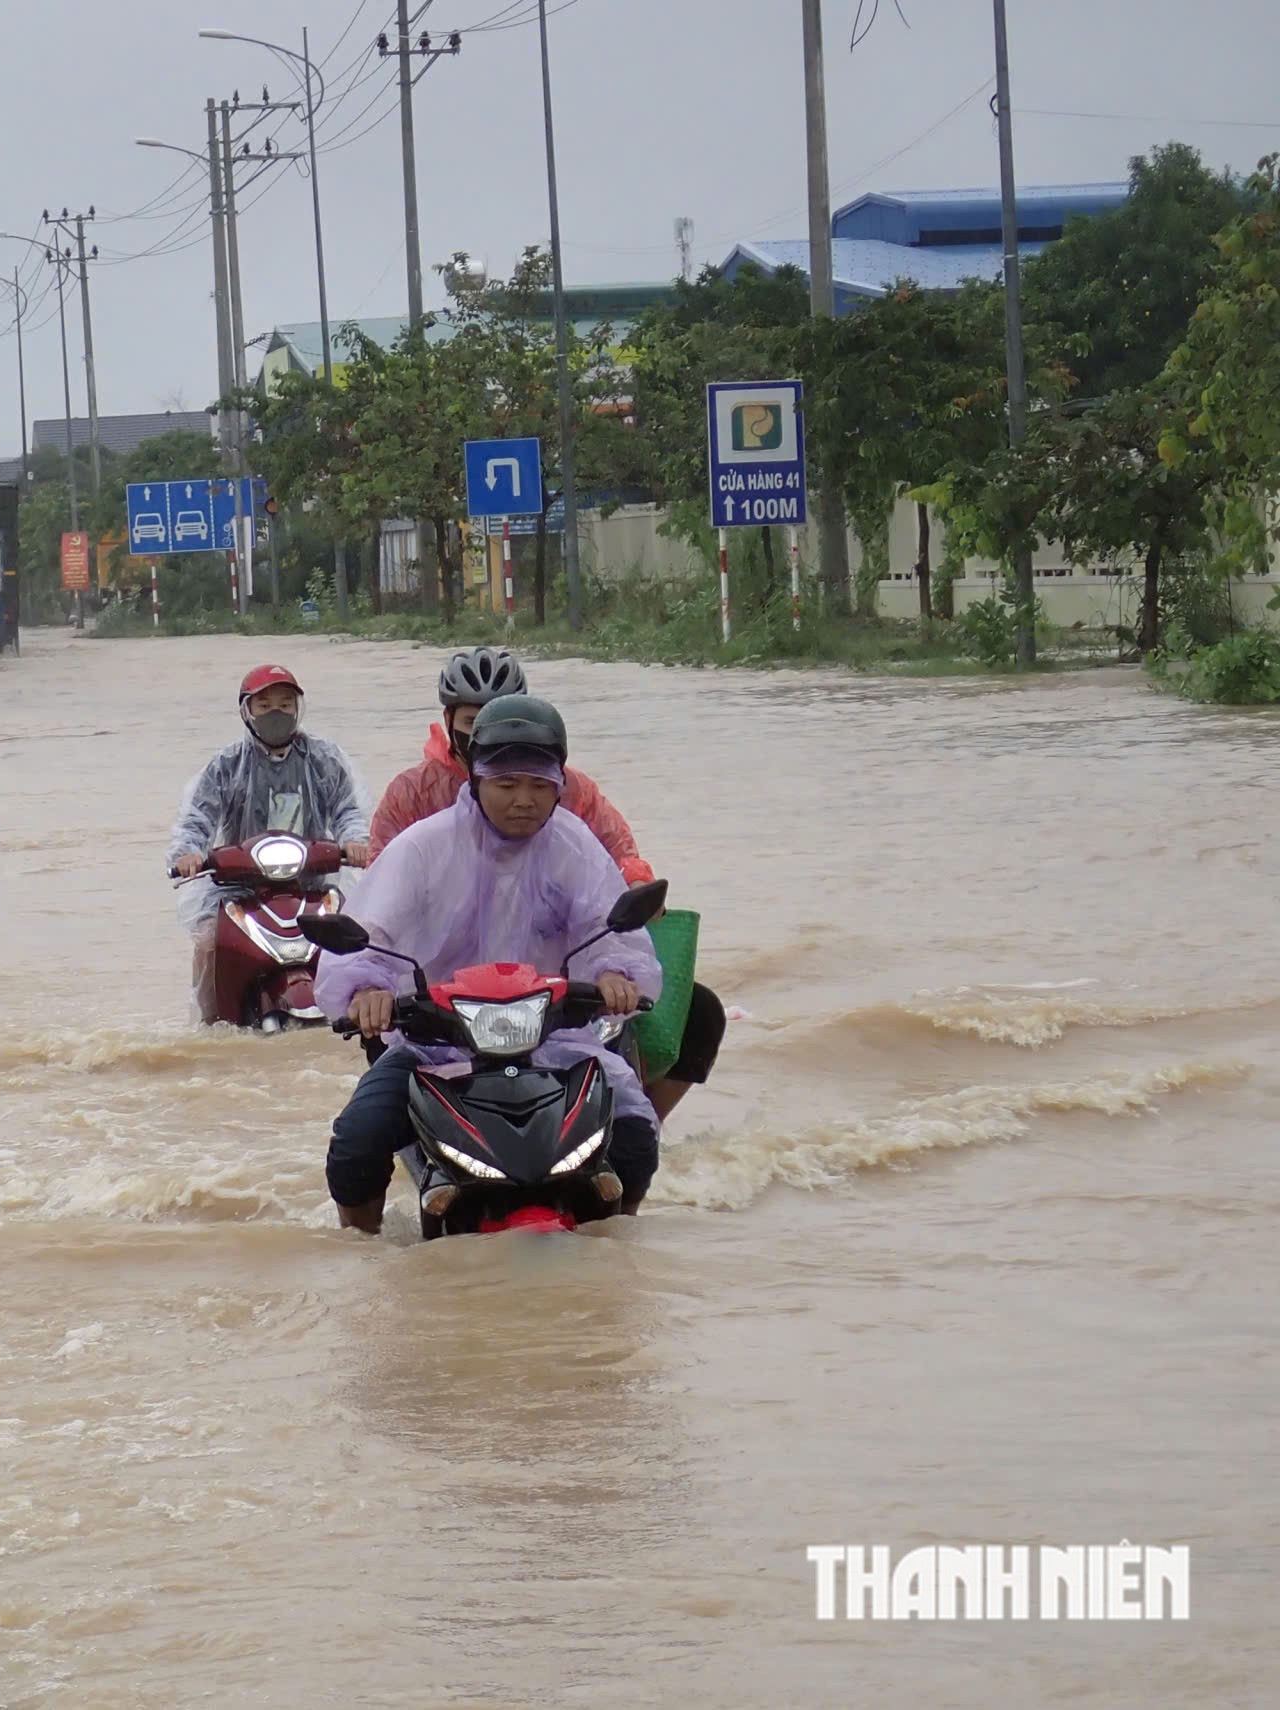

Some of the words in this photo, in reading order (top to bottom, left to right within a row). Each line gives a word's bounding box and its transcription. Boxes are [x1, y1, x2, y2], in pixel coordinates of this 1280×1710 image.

[720, 469, 745, 491] CỬA
[748, 470, 783, 490] HÀNG
[786, 472, 800, 488] 41
[741, 498, 797, 520] 100M
